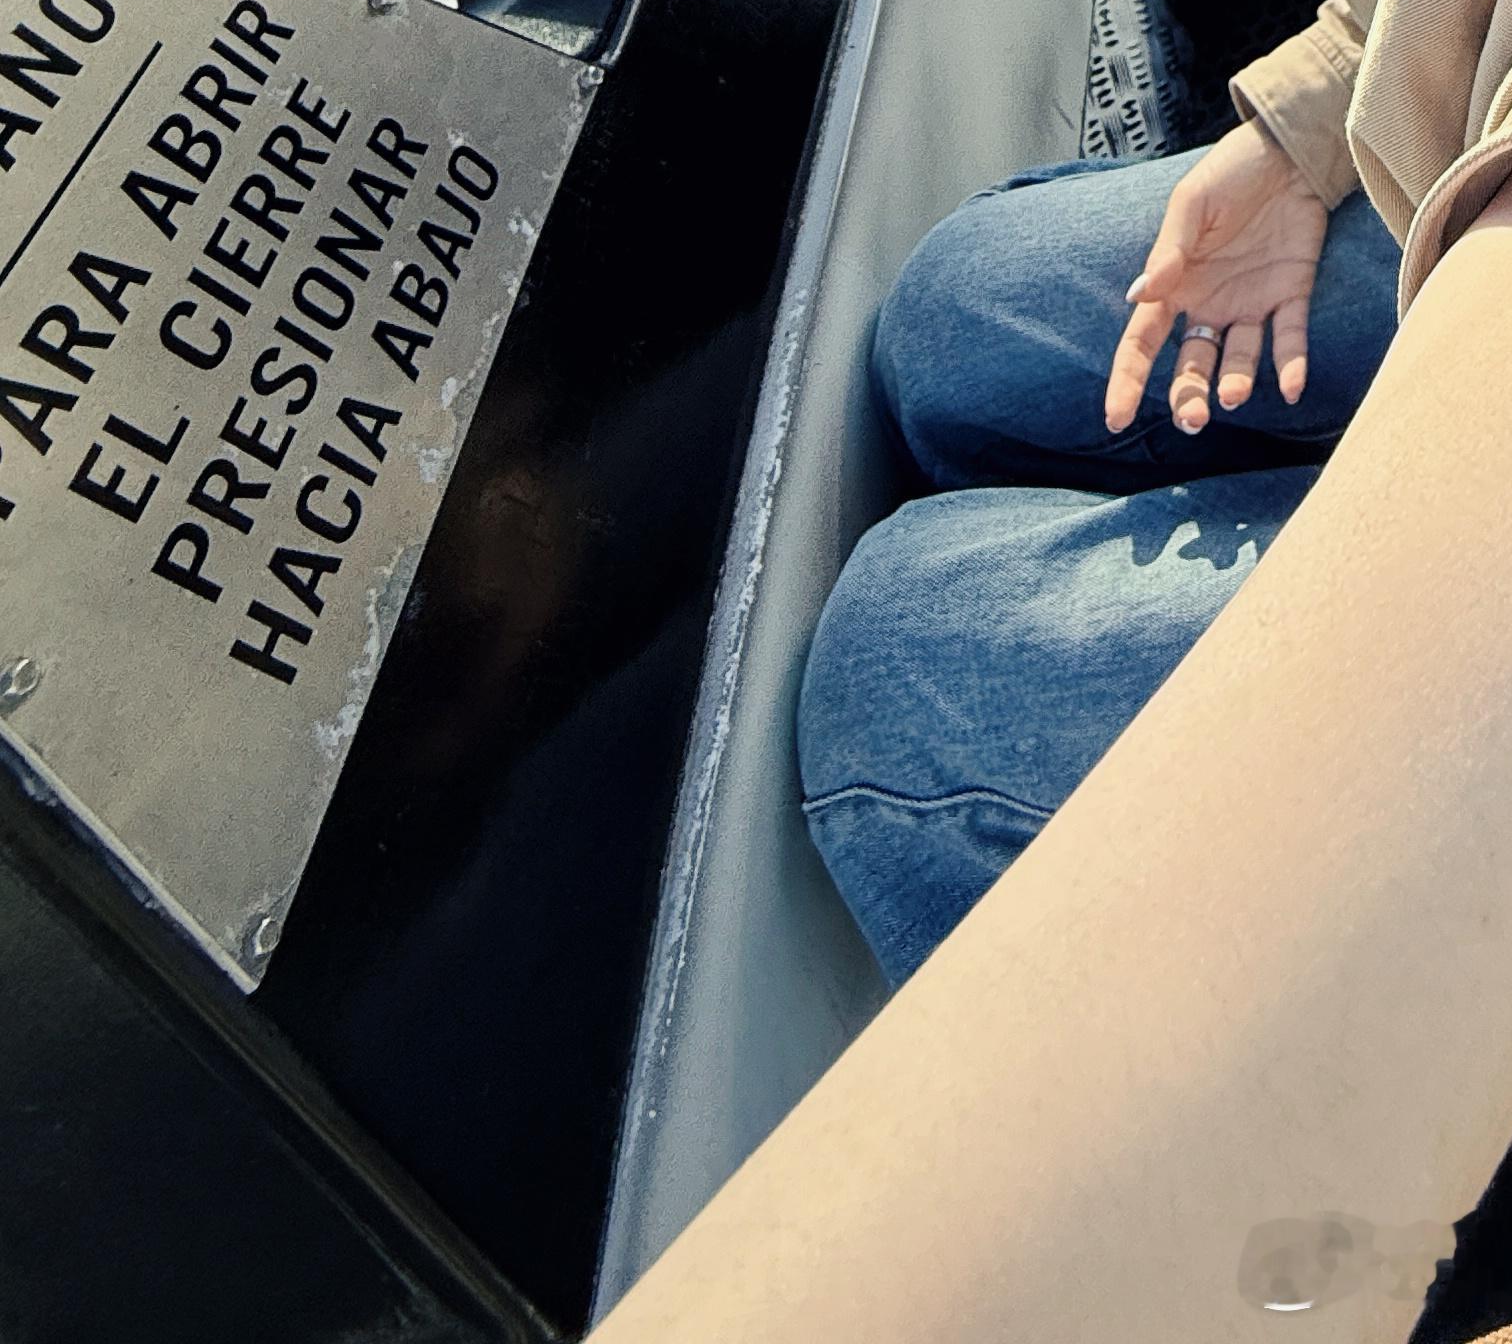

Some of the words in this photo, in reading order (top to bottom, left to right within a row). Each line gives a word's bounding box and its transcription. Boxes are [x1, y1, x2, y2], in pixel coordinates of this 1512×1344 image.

[0, 251, 153, 521] ARA
[119, 0, 296, 242] ABRIR
[67, 414, 191, 524] EL
[159, 77, 352, 371] CIERRE
[150, 117, 430, 604] PRESIONAR
[228, 397, 403, 686] HACIA
[370, 145, 499, 384] ABAJO
